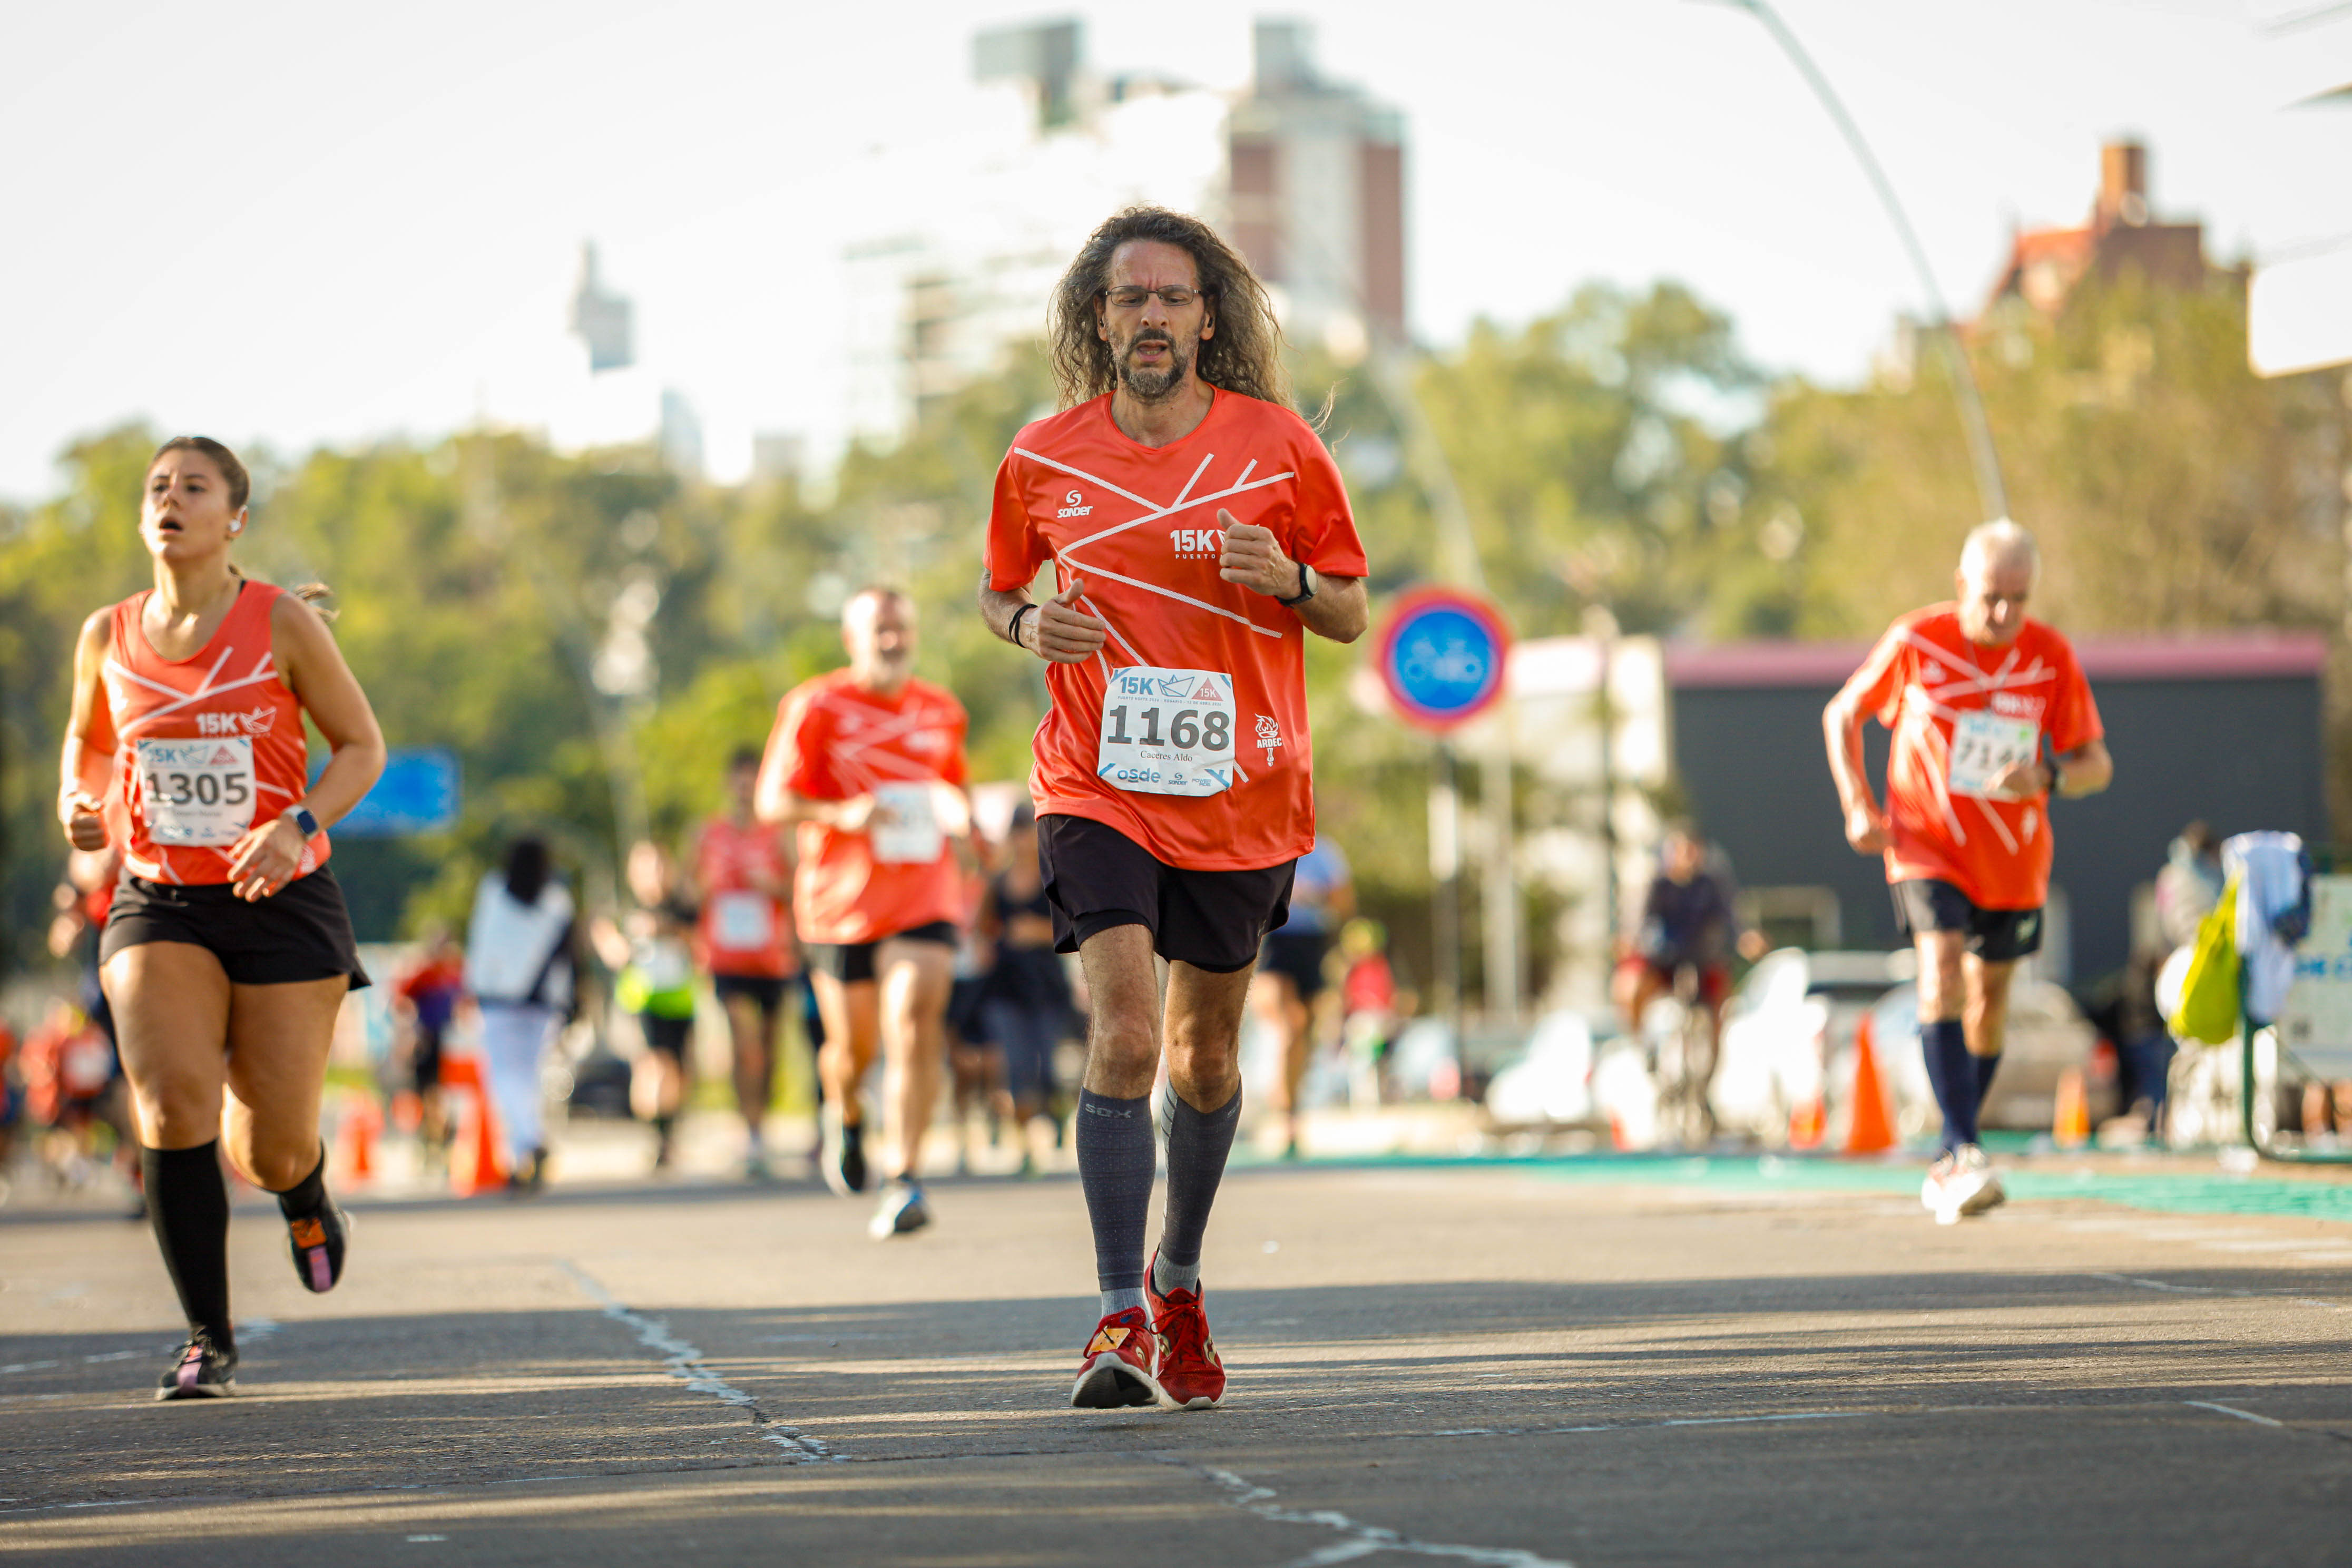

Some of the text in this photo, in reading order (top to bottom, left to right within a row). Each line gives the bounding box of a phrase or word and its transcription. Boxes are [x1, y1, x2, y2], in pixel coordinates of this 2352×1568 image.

[1170, 529, 1216, 552] 15K
[1120, 677, 1154, 695] 15K
[1200, 688, 1216, 698] 15K
[195, 712, 239, 734] 15K
[1107, 705, 1230, 751] 1168
[1257, 737, 1282, 749] ARDEC
[1140, 750, 1193, 762] Caceres Aldo
[1117, 768, 1161, 783] osde
[145, 772, 249, 806] 1305
